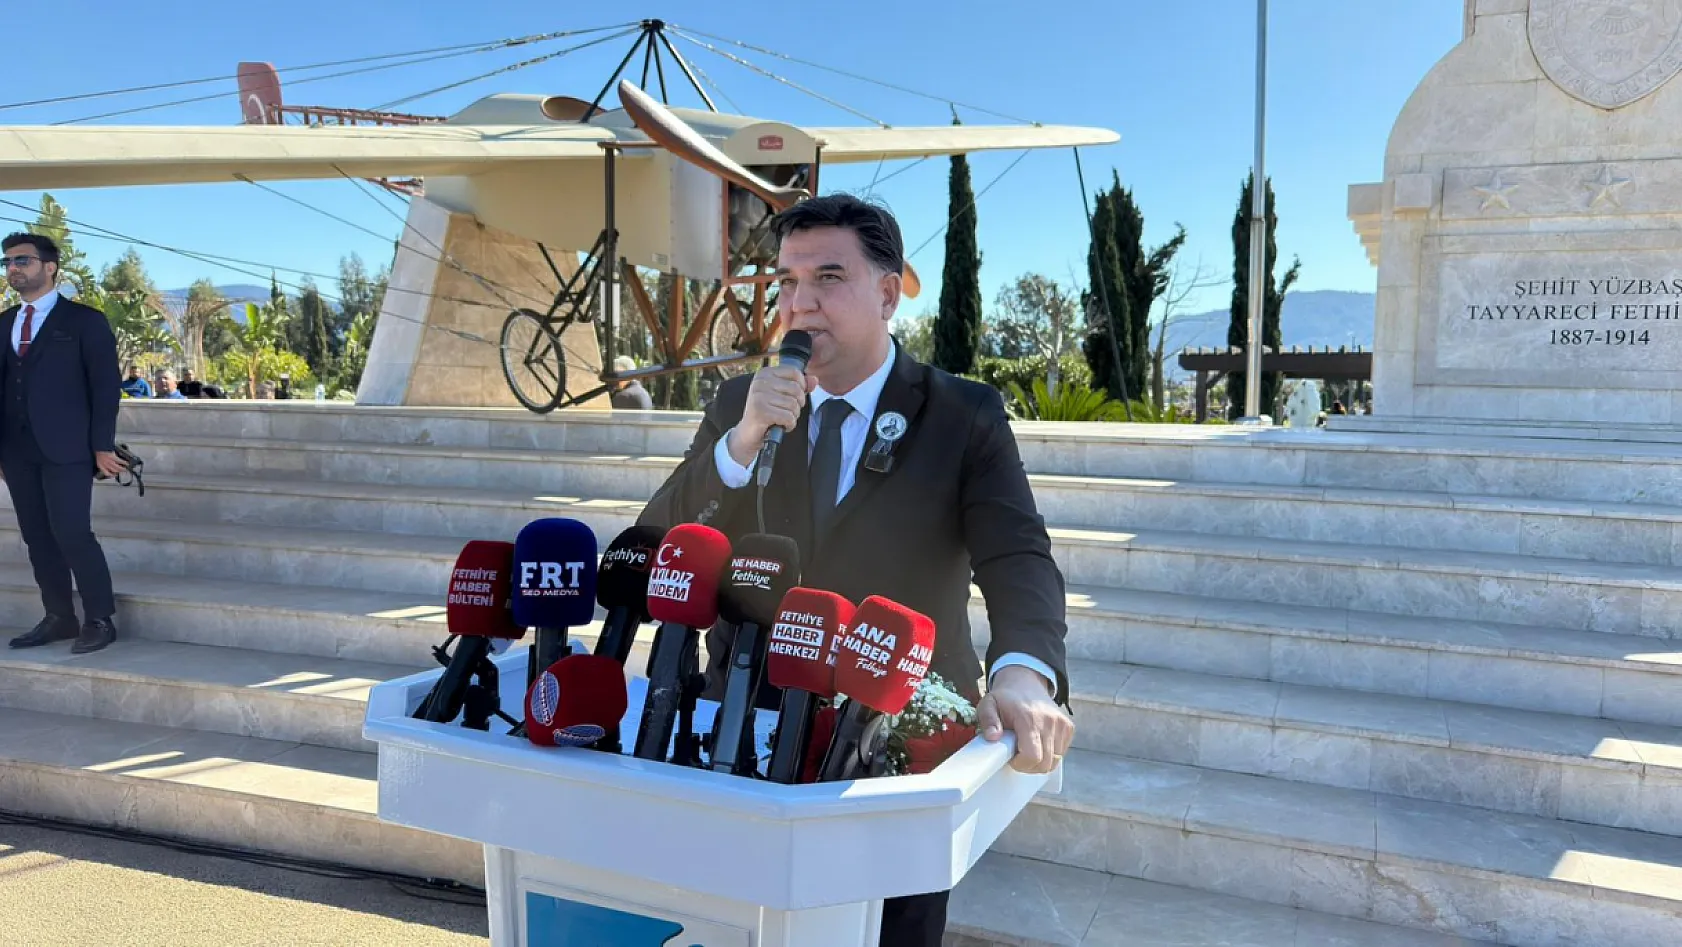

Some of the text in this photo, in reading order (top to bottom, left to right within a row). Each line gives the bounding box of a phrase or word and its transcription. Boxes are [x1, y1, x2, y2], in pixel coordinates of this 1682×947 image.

[1514, 277, 1581, 298] ŞEHİT
[1467, 301, 1681, 320] TAYYARECİ FETHİ
[1550, 329, 1651, 346] 1887-1914
[603, 547, 647, 564] Fethiye
[452, 567, 499, 581] FETHİYE
[731, 558, 780, 573] NE HABER
[519, 561, 586, 589] FRT
[650, 567, 695, 585] YILDIZ
[731, 570, 770, 585] Fethiye
[452, 582, 492, 593] HABER
[542, 589, 581, 597] MEDYA
[448, 592, 495, 607] BÜLTENİ
[780, 611, 824, 628] FETHİYE
[775, 625, 820, 643] HABER
[853, 622, 897, 651] ANA
[768, 642, 820, 661] MERKEZİ
[843, 634, 892, 665] HABER
